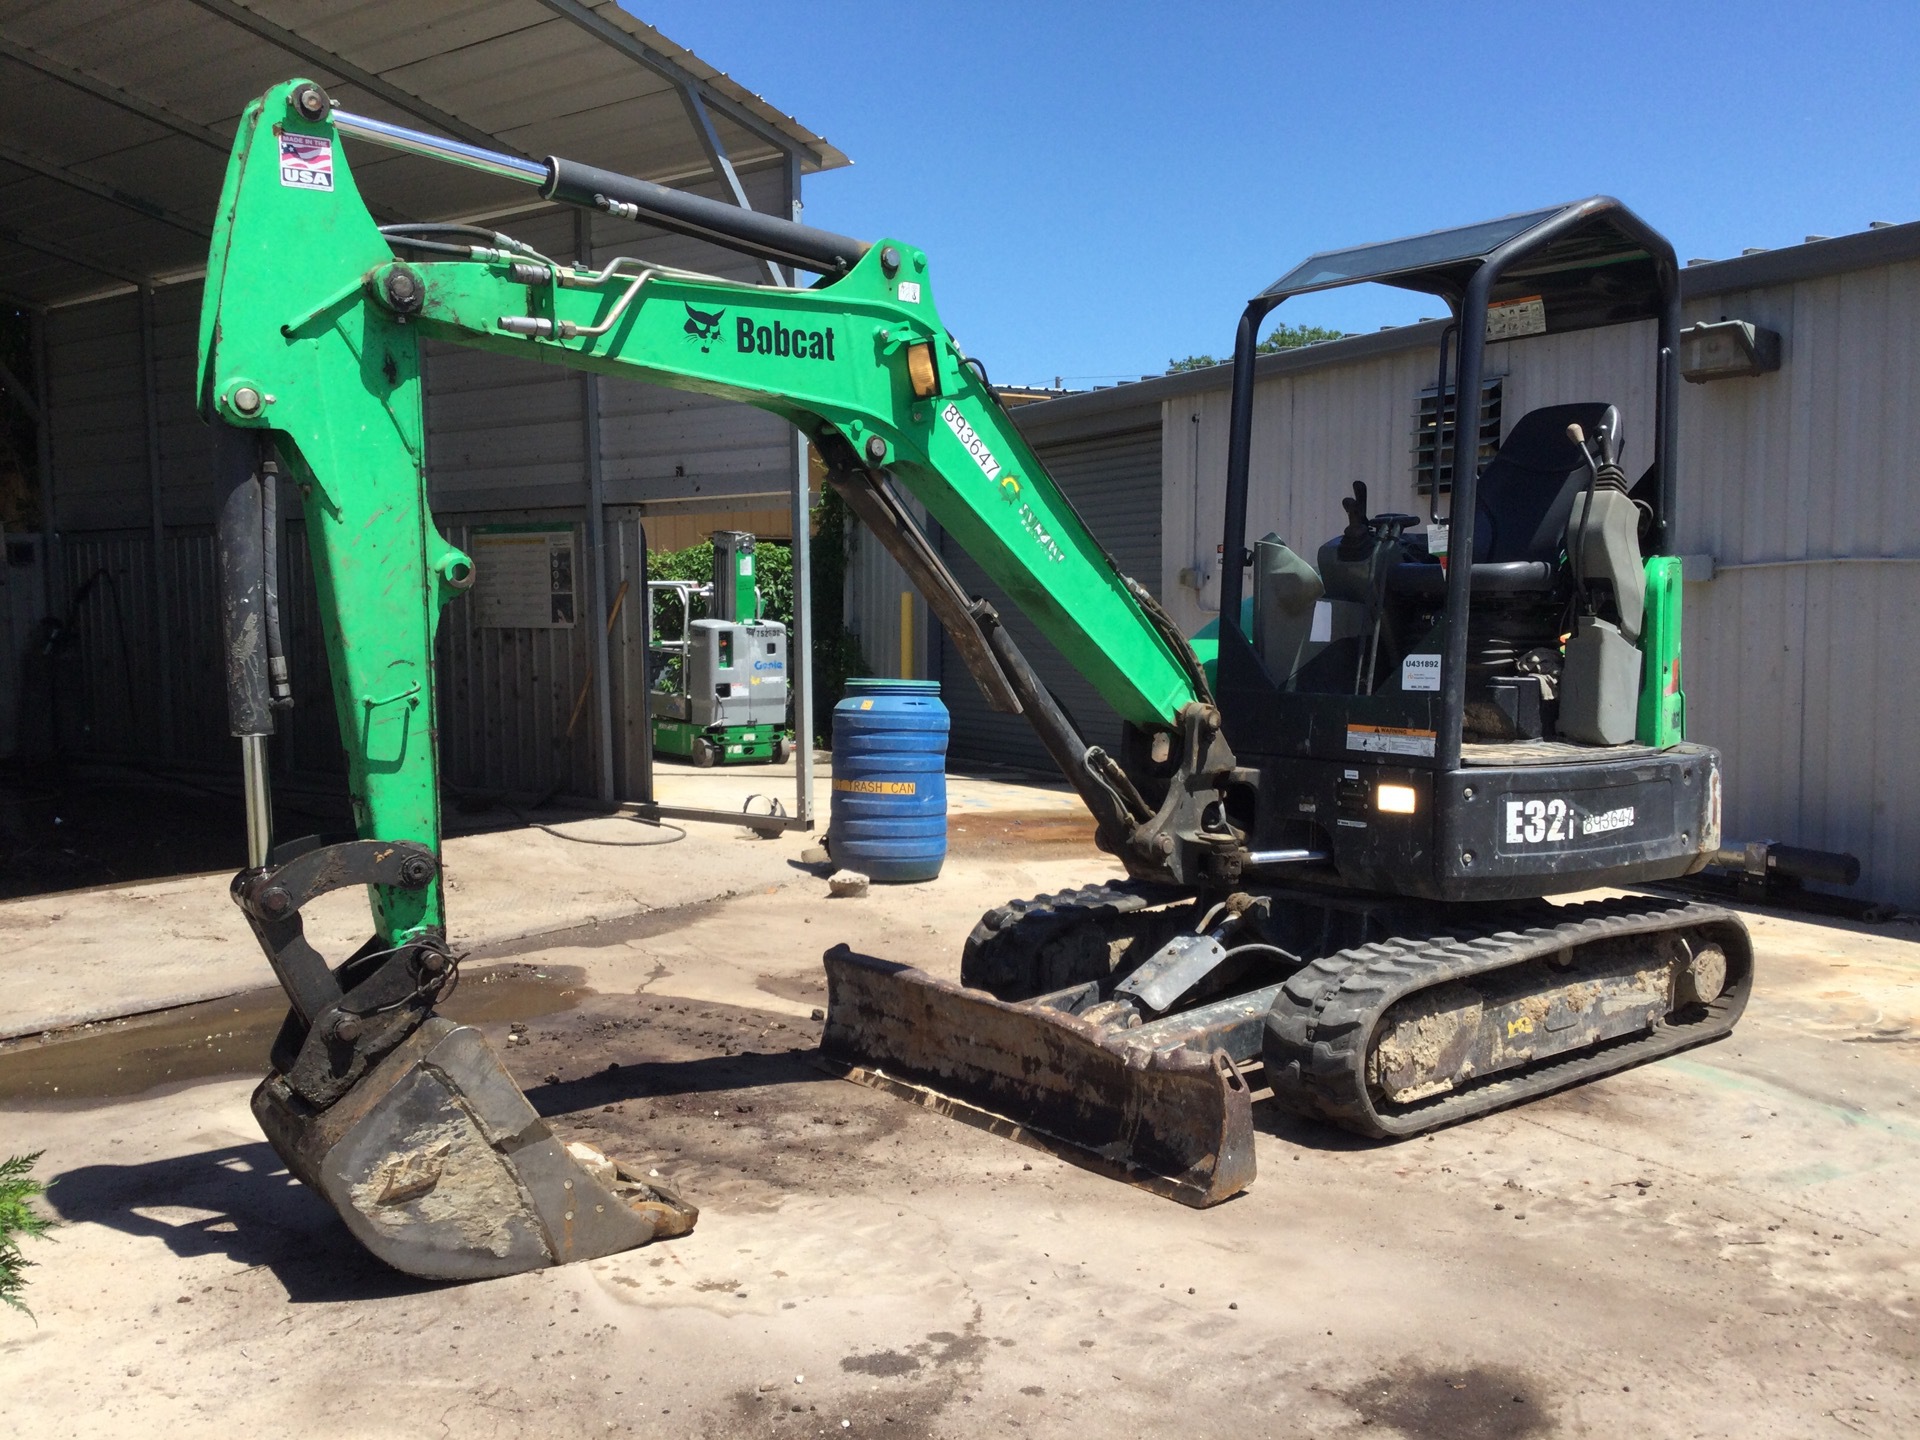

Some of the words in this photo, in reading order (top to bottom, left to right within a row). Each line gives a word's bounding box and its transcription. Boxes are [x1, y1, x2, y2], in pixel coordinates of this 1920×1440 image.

[282, 135, 304, 144] MADE
[284, 168, 330, 186] USA
[736, 316, 835, 361] Bobcat
[943, 404, 1001, 475] 893647
[1405, 660, 1439, 668] U431892
[849, 780, 883, 793] TRASH
[891, 782, 914, 794] CAN
[1506, 799, 1575, 843] E32i
